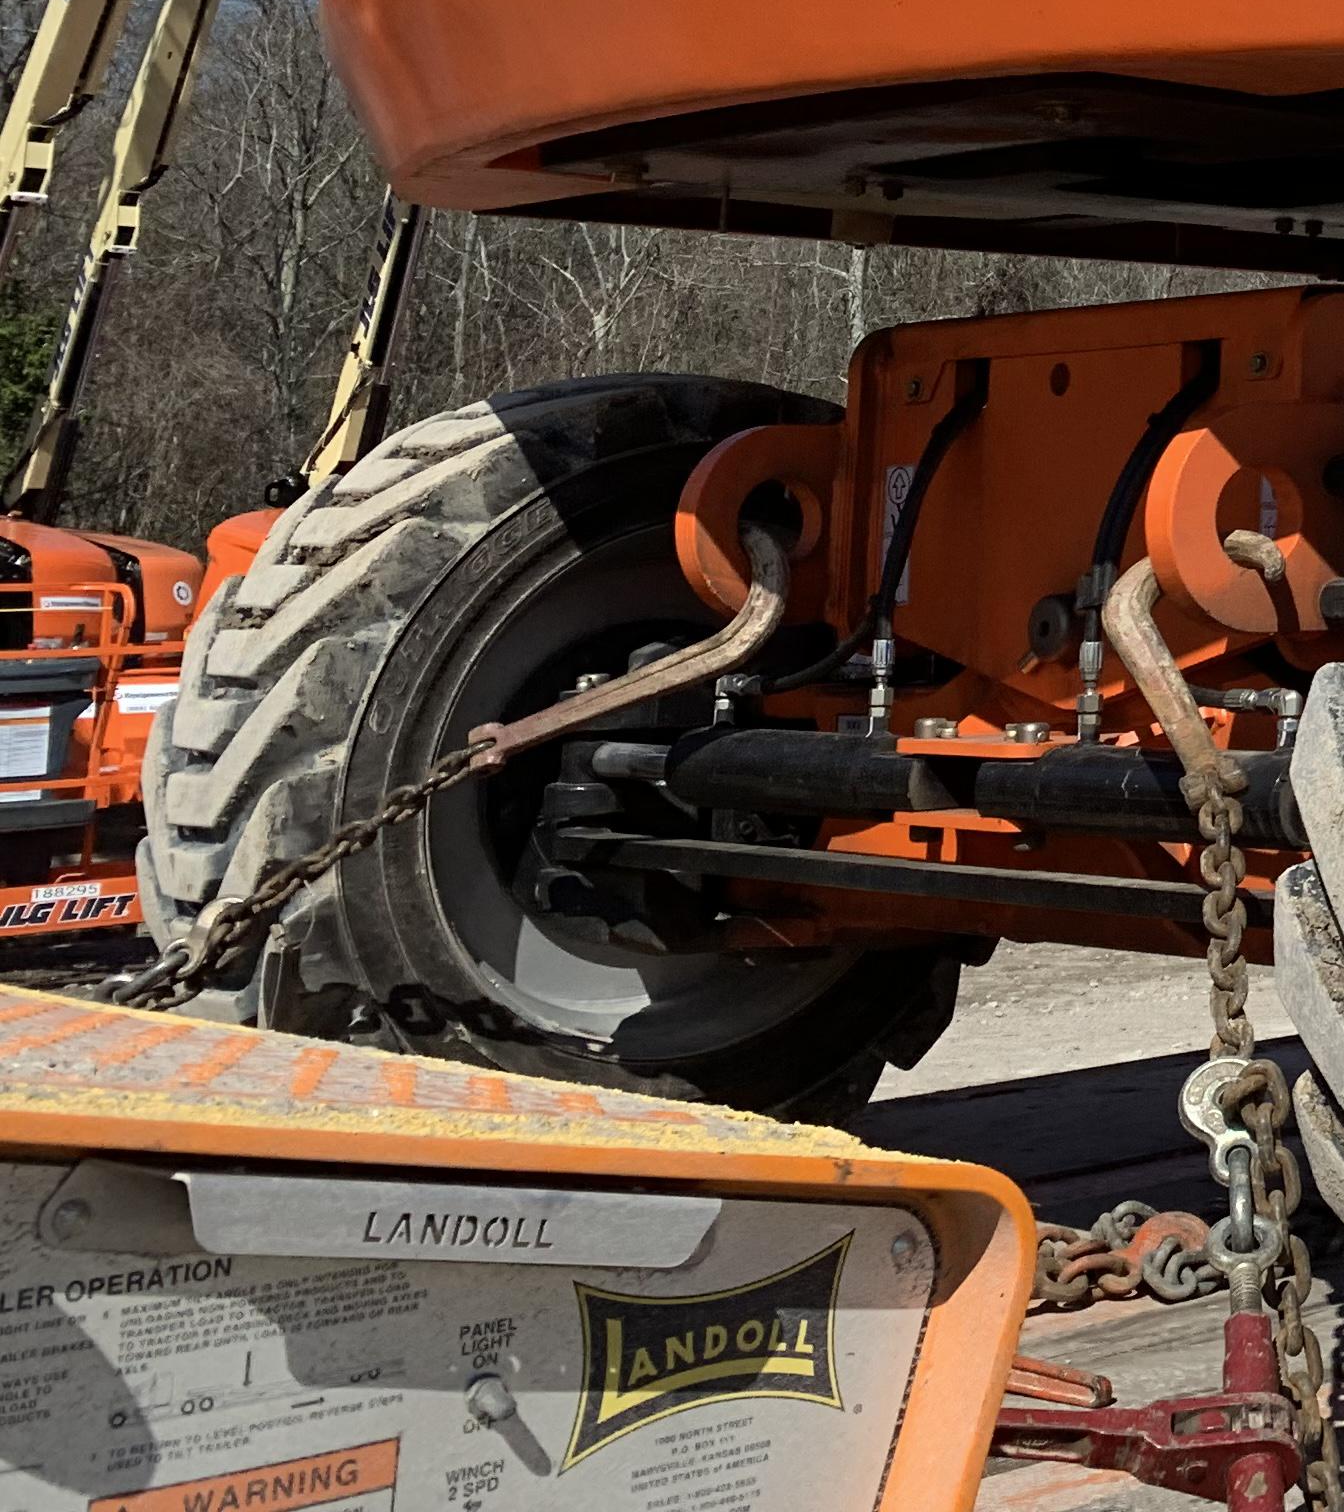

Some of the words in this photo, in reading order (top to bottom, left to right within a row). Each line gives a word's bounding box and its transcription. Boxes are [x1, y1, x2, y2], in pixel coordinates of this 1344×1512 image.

[58, 892, 137, 923] LIFT
[362, 1211, 554, 1249] LANDOLL
[64, 1256, 233, 1303] OPERATION
[459, 1317, 518, 1339] PANEL
[461, 1332, 517, 1356] LIGHT
[472, 1351, 499, 1369] ON
[596, 1317, 816, 1425] LANDOLL
[182, 1457, 361, 1512] WARNING
[445, 1459, 505, 1486] WINCH
[447, 1487, 458, 1502] 2
[462, 1476, 500, 1499] SPD
